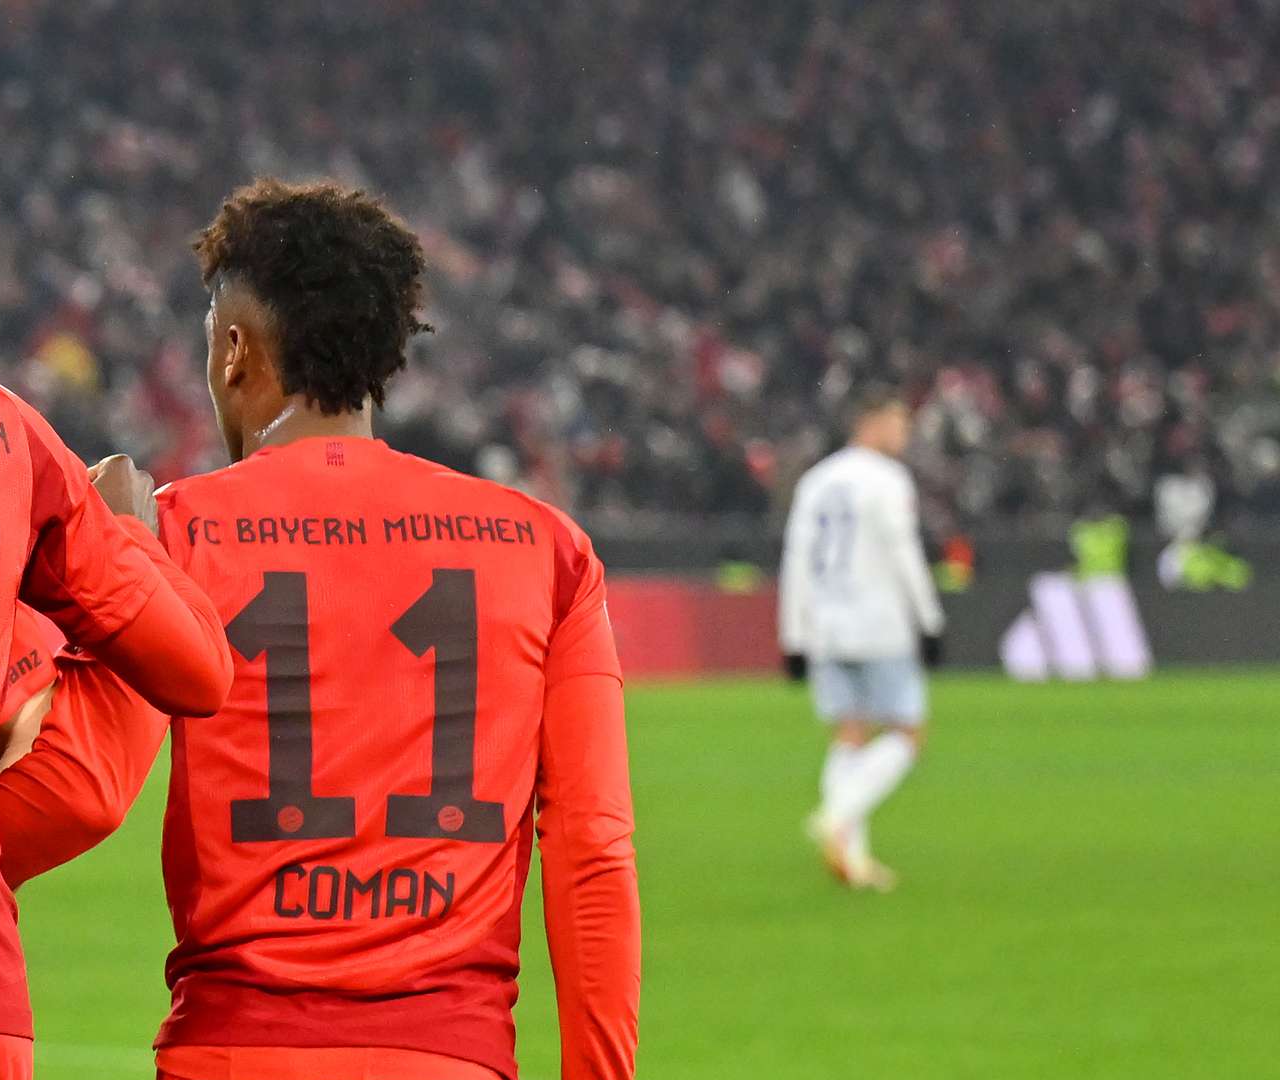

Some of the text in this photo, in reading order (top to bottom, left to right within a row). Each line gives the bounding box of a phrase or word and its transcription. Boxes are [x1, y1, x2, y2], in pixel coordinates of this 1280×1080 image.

[186, 513, 536, 547] FC BAYERN MÜNCHEN
[224, 568, 507, 844] 11
[273, 864, 456, 920] COMAN
